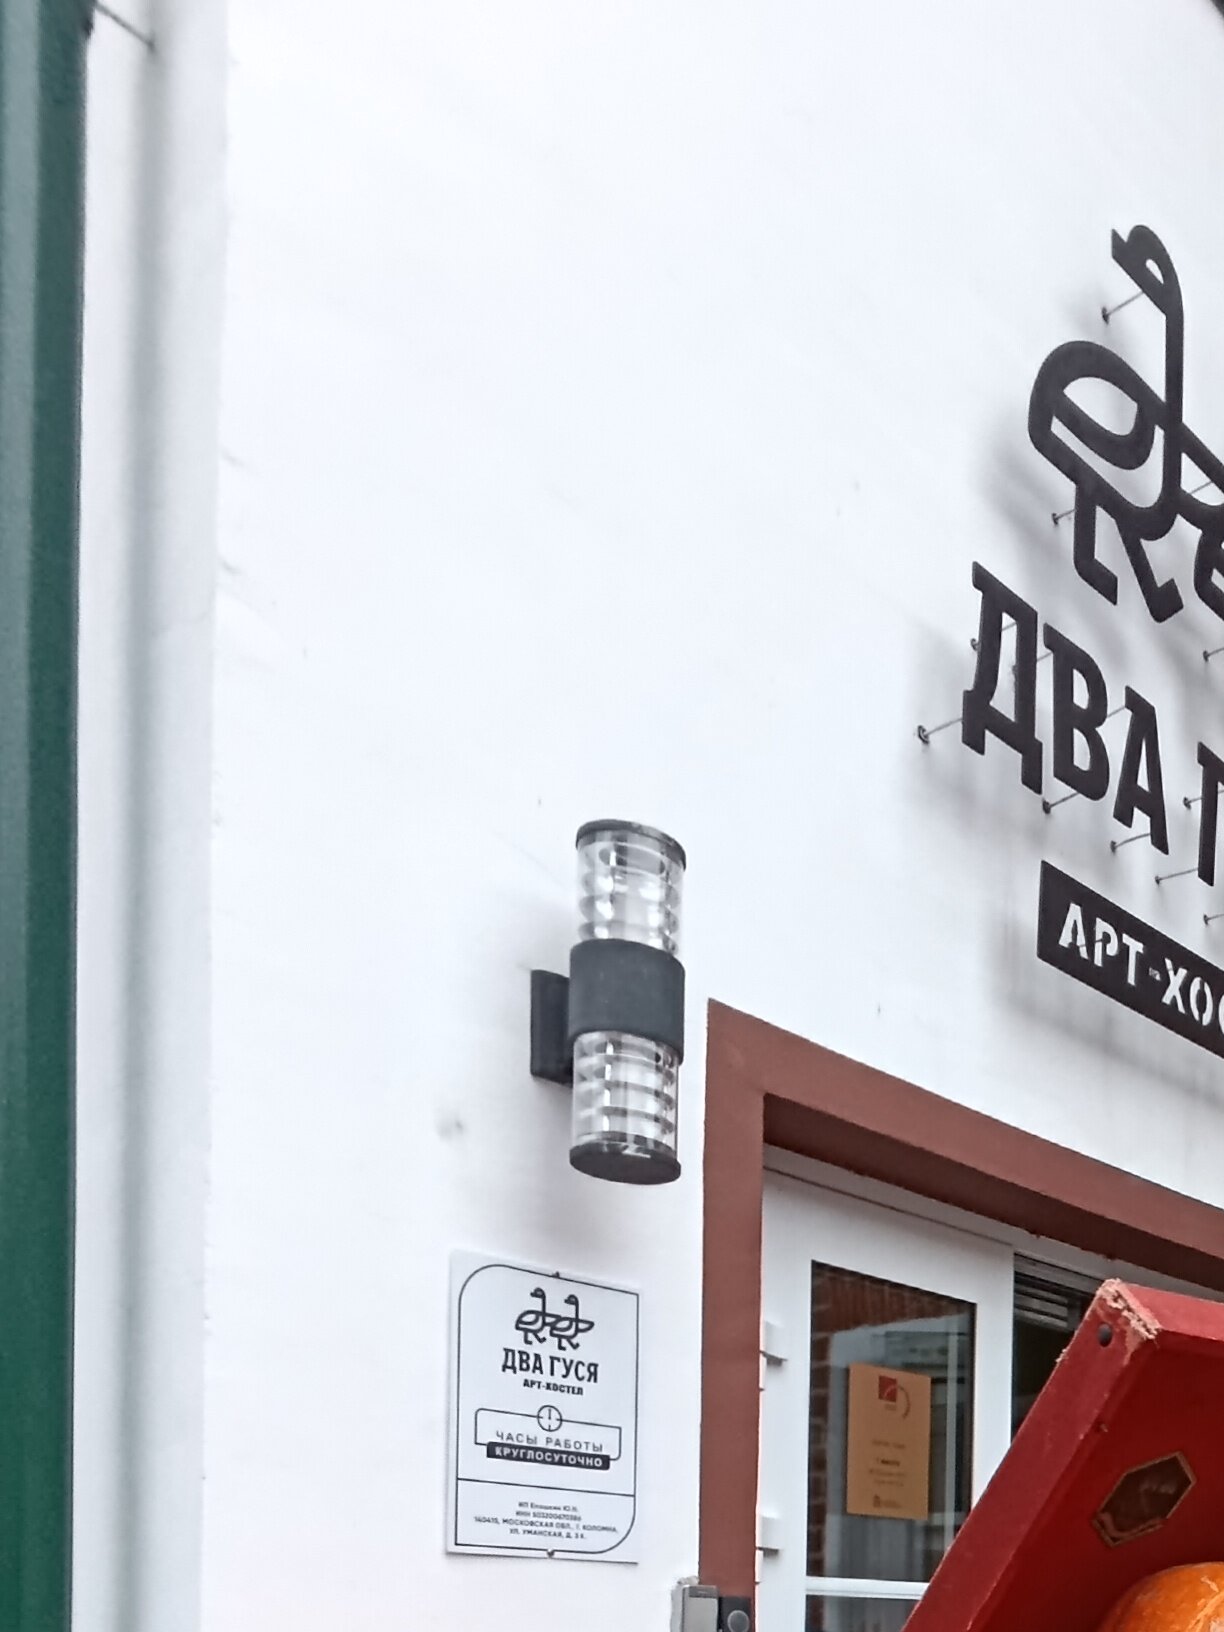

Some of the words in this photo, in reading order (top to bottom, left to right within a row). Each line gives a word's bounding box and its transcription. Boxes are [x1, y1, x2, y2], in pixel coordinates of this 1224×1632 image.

[961, 561, 1169, 855] ДВА
[501, 1347, 544, 1375] ДВА
[549, 1355, 599, 1383] ГУСЯ
[496, 1430, 537, 1445] ЧАСЫ
[545, 1437, 603, 1452] РАБОТЫ
[494, 1446, 603, 1467] КРУГЛОСУТОЧНО
[502, 1518, 554, 1528] МОСКОВСКАЯ
